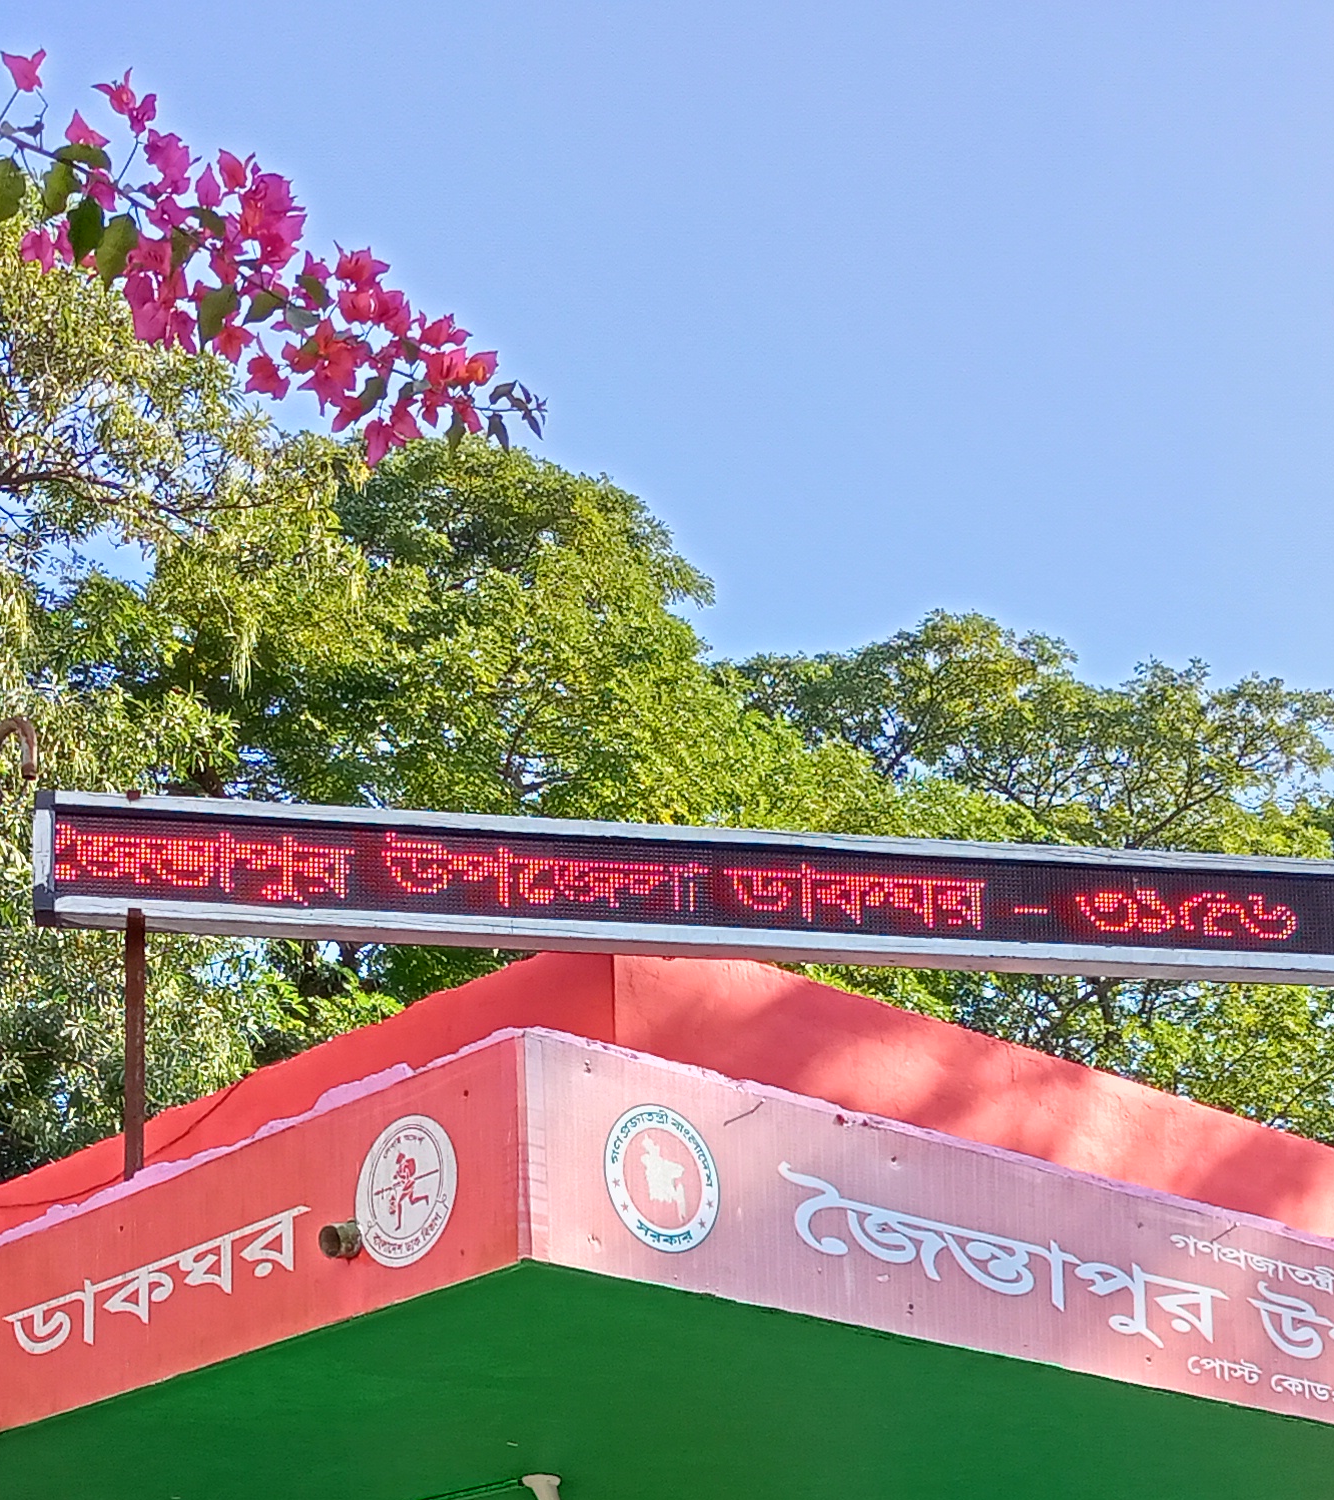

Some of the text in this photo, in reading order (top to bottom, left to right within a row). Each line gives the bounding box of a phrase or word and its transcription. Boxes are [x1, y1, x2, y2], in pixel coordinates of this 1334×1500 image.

[381, 829, 710, 912] উপজেলা
[723, 862, 985, 931] ডাকঘর
[3, 1204, 312, 1355] ডাকঘর
[636, 1219, 694, 1246] সরকার
[777, 1160, 1230, 1350] জৈন্তাপুর
[1186, 1353, 1262, 1385] পোস্ট
